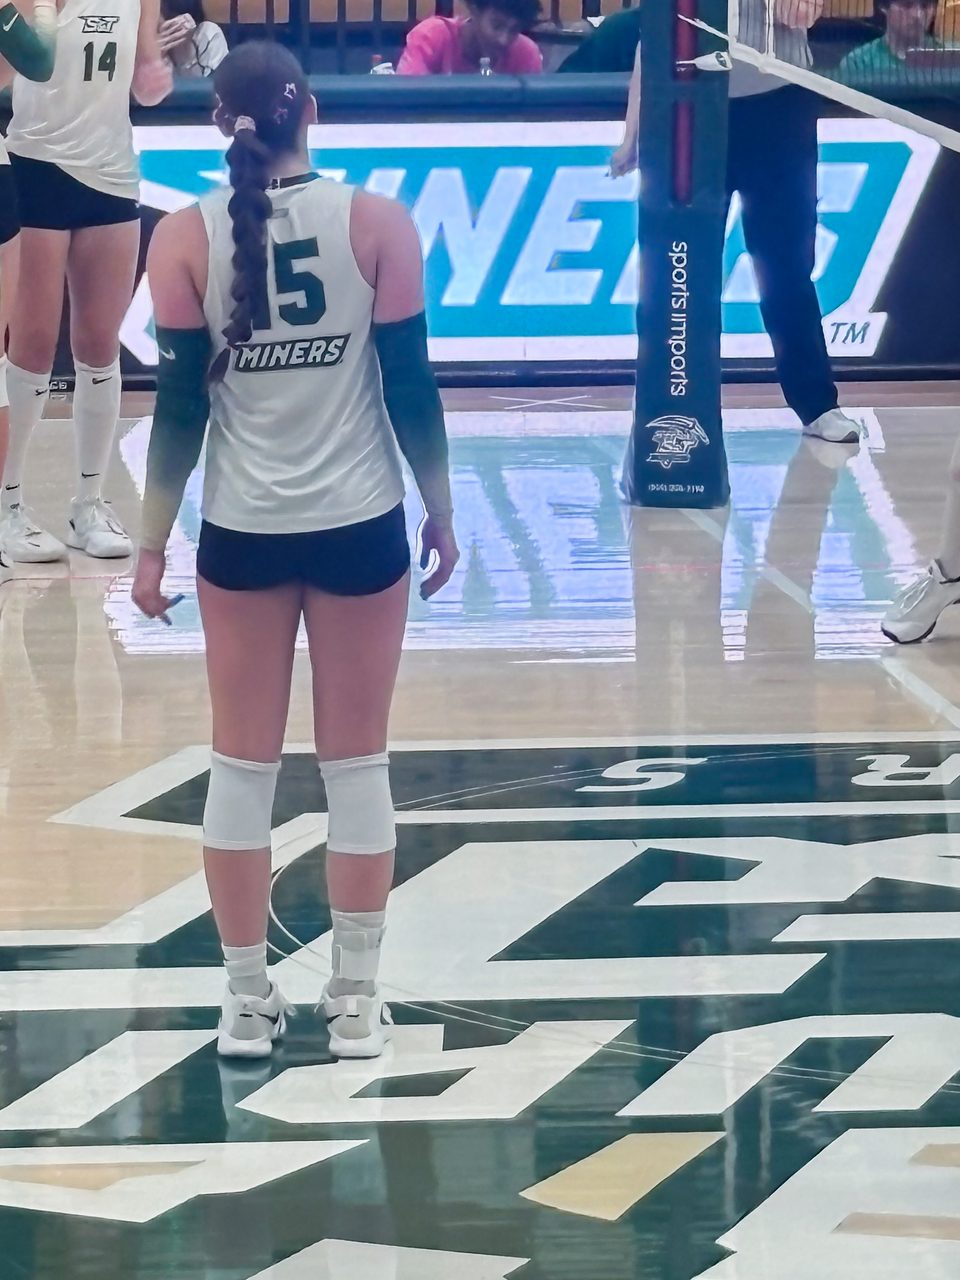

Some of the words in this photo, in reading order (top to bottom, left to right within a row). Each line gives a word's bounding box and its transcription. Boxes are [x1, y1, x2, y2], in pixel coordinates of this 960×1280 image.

[83, 41, 117, 81] 14
[830, 322, 871, 345] TM
[238, 337, 346, 369] MINERS
